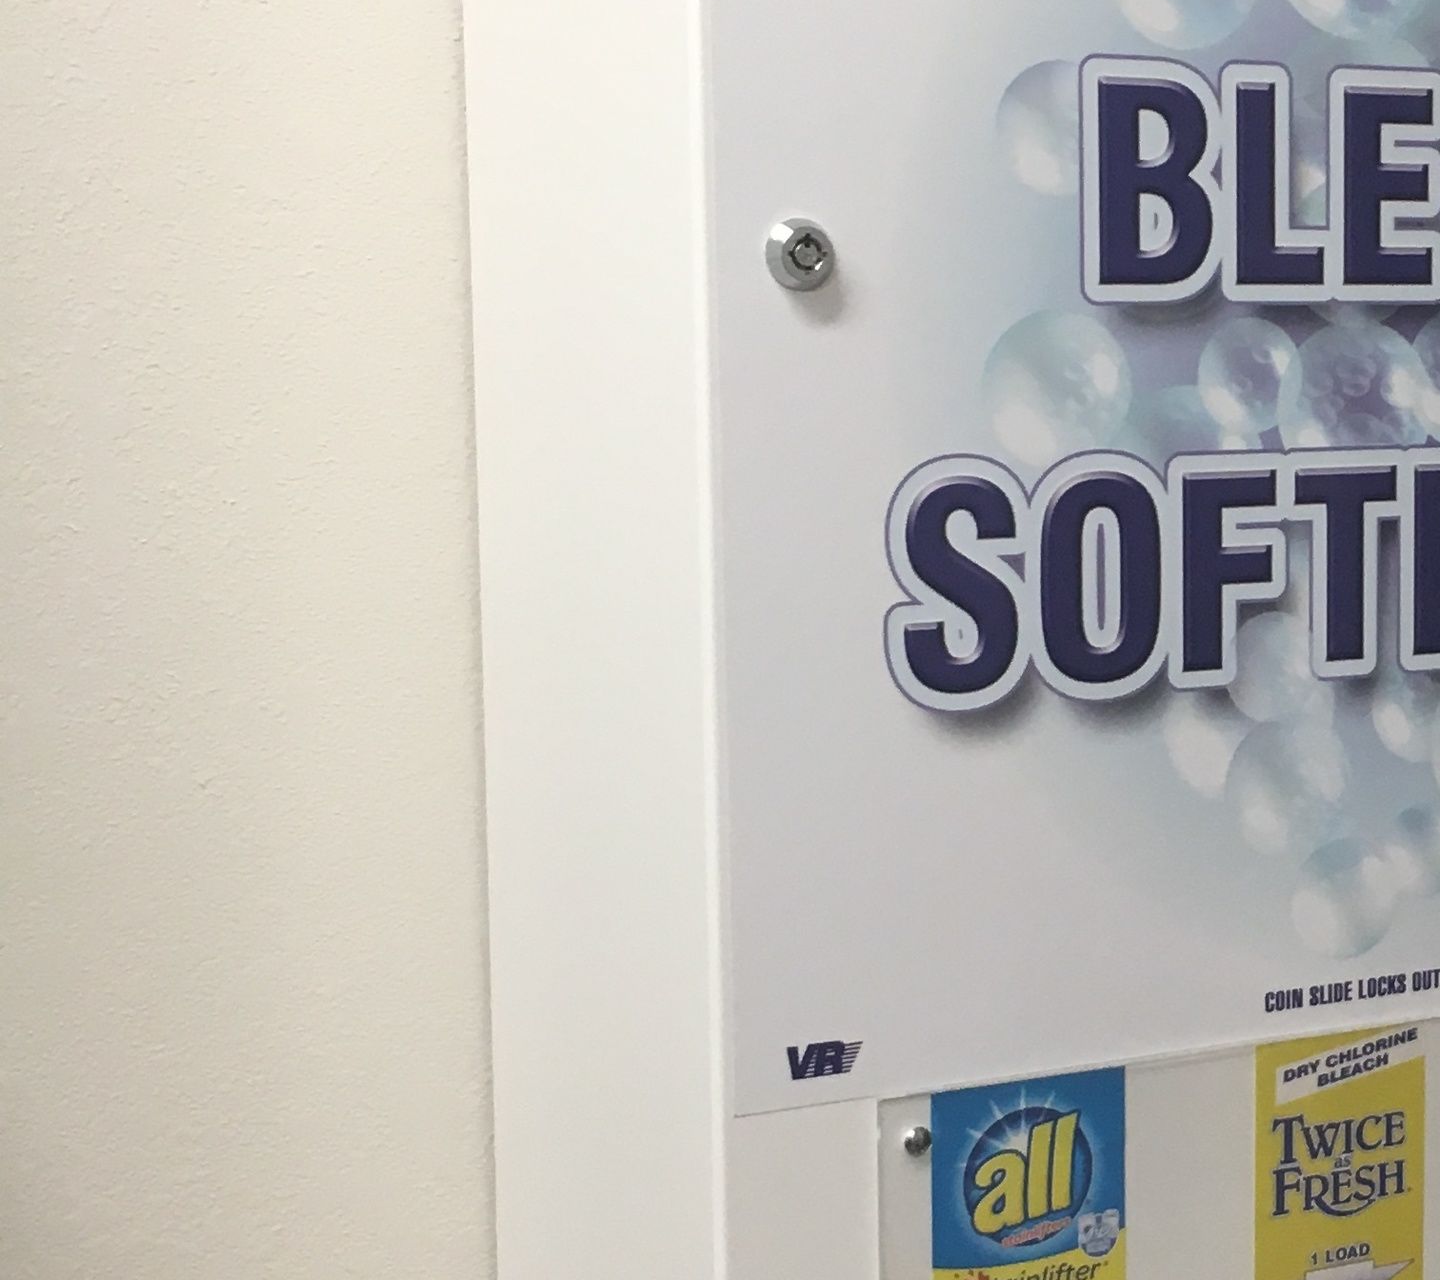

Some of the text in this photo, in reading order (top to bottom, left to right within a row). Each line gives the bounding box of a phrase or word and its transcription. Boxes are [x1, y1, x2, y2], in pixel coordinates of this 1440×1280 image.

[1264, 988, 1304, 1013] COIN
[1309, 981, 1353, 1007] SLIDE
[1358, 973, 1407, 1000] LOCKS
[1282, 1027, 1418, 1083] DRY CHLORINE
[1316, 1052, 1389, 1088] BLEACH
[1271, 1110, 1406, 1165] TWICE
[1334, 1153, 1352, 1169] as
[972, 1109, 1080, 1236] all
[1271, 1158, 1406, 1218] FRESH
[1310, 1242, 1371, 1265] 1 LOAD
